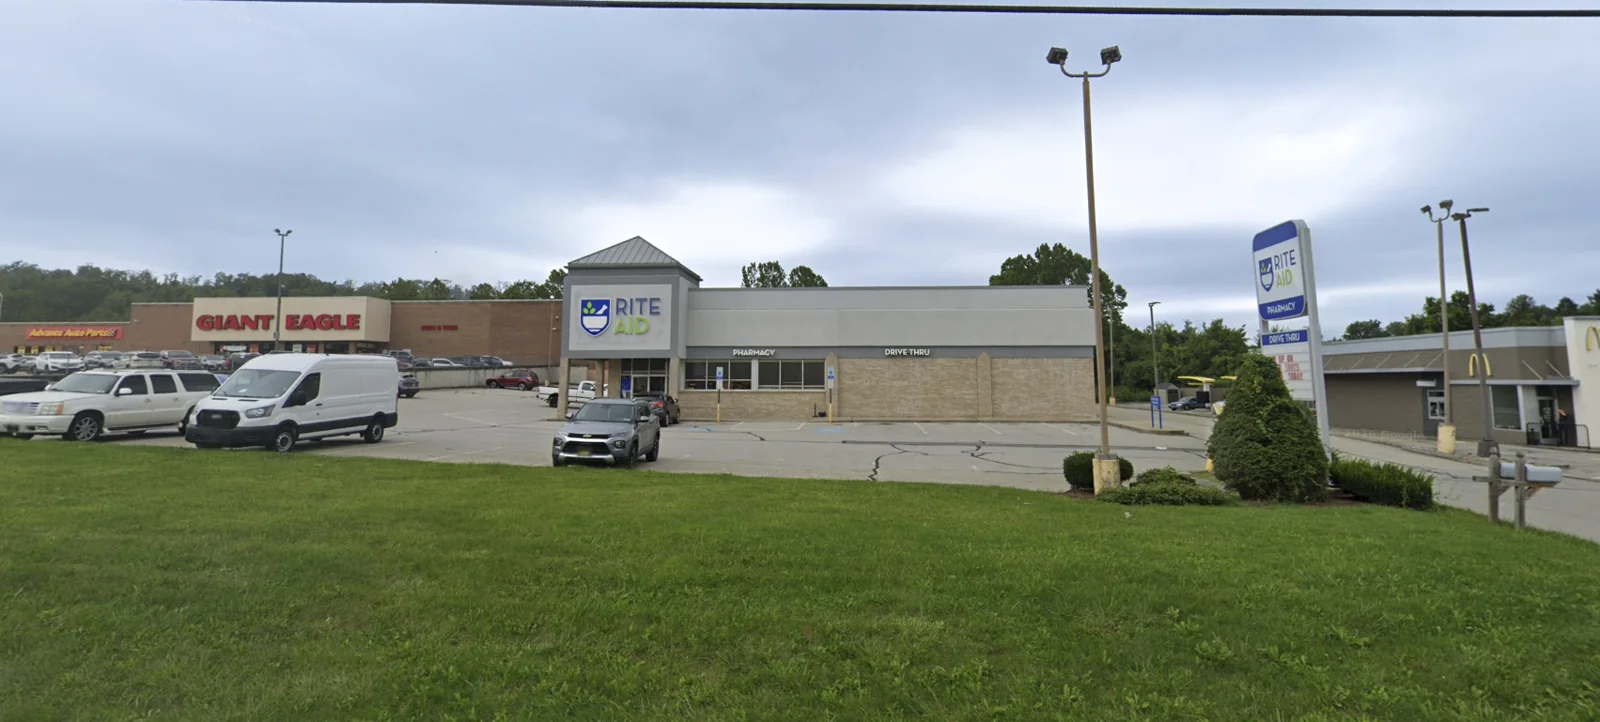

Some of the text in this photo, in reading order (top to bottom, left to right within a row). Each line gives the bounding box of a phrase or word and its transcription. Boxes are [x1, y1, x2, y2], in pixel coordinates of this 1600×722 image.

[1274, 249, 1296, 270] RITE
[1276, 269, 1293, 287] AID
[616, 298, 661, 315] RITE
[1267, 301, 1296, 314] PHARMACY
[196, 314, 361, 331] GIANT EAGLE
[613, 316, 650, 335] AID
[30, 329, 109, 337] Advance Auto Parts
[1269, 331, 1300, 344] DRIVE THRU
[732, 348, 776, 356] PHARMACY
[884, 348, 930, 356] DRIVE THRU
